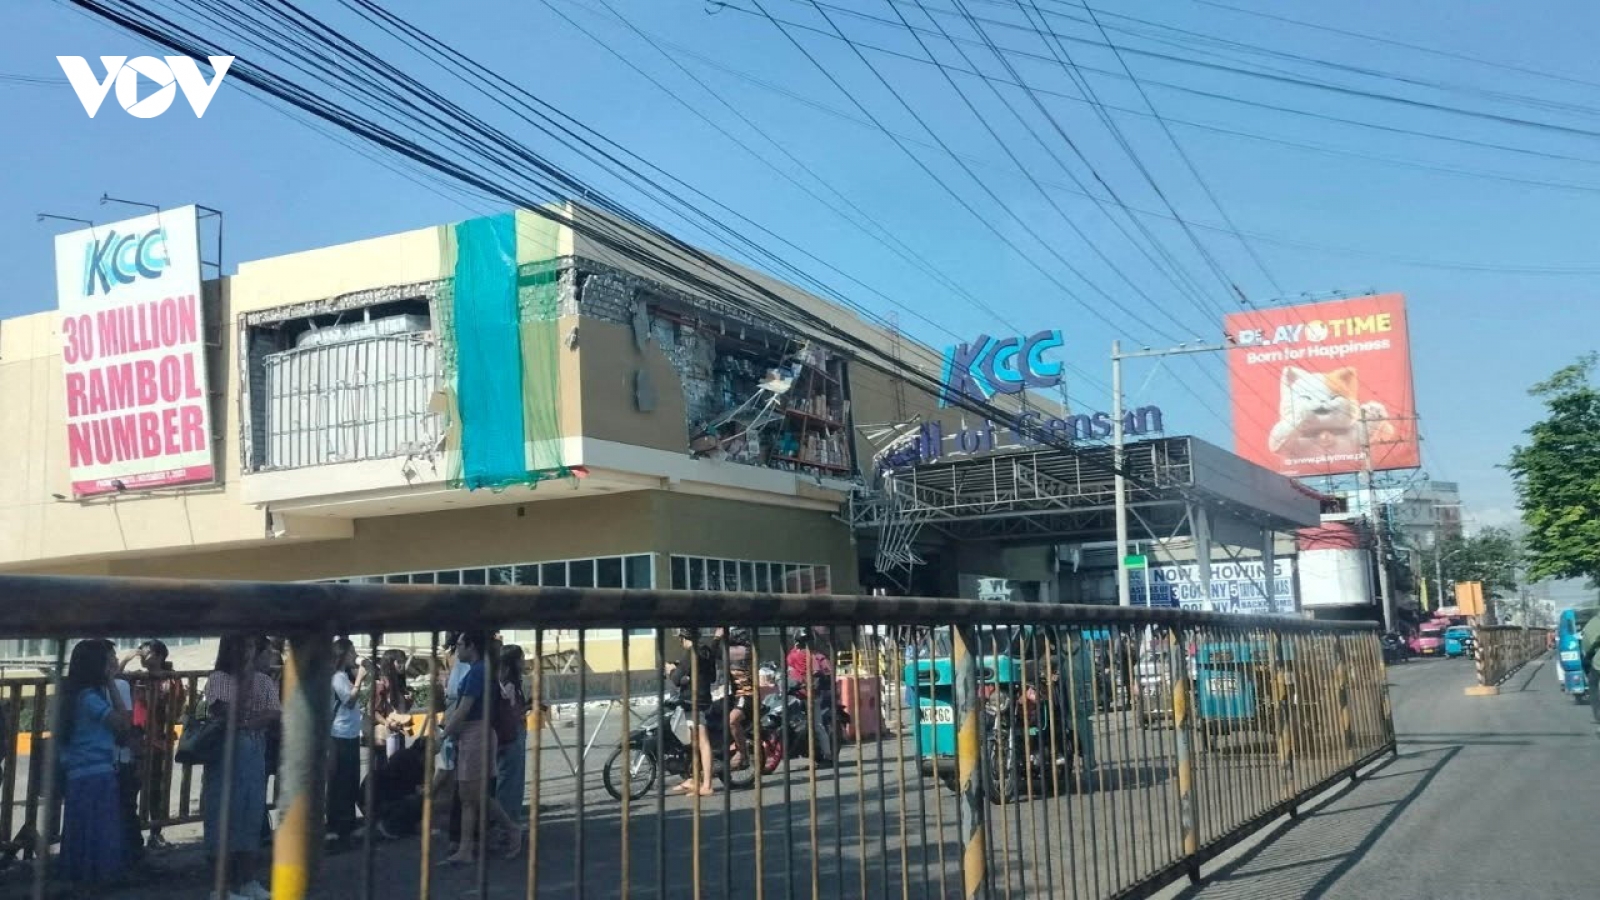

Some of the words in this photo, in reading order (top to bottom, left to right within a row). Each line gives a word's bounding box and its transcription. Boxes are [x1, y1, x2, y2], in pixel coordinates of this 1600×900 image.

[83, 225, 169, 297] KCC
[62, 314, 94, 365] 30
[97, 294, 197, 359] MILLION
[1329, 312, 1392, 338] TIME
[939, 330, 1064, 409] KCC
[1246, 350, 1283, 365] Born
[1284, 347, 1305, 361] for
[1307, 339, 1391, 360] Happiness
[66, 353, 202, 417] RAMBOL
[67, 405, 206, 468] NUMBER
[1154, 568, 1192, 582] NOW
[1199, 563, 1282, 580] HOWING
[1172, 586, 1181, 600] 3
[1230, 584, 1239, 597] 5
